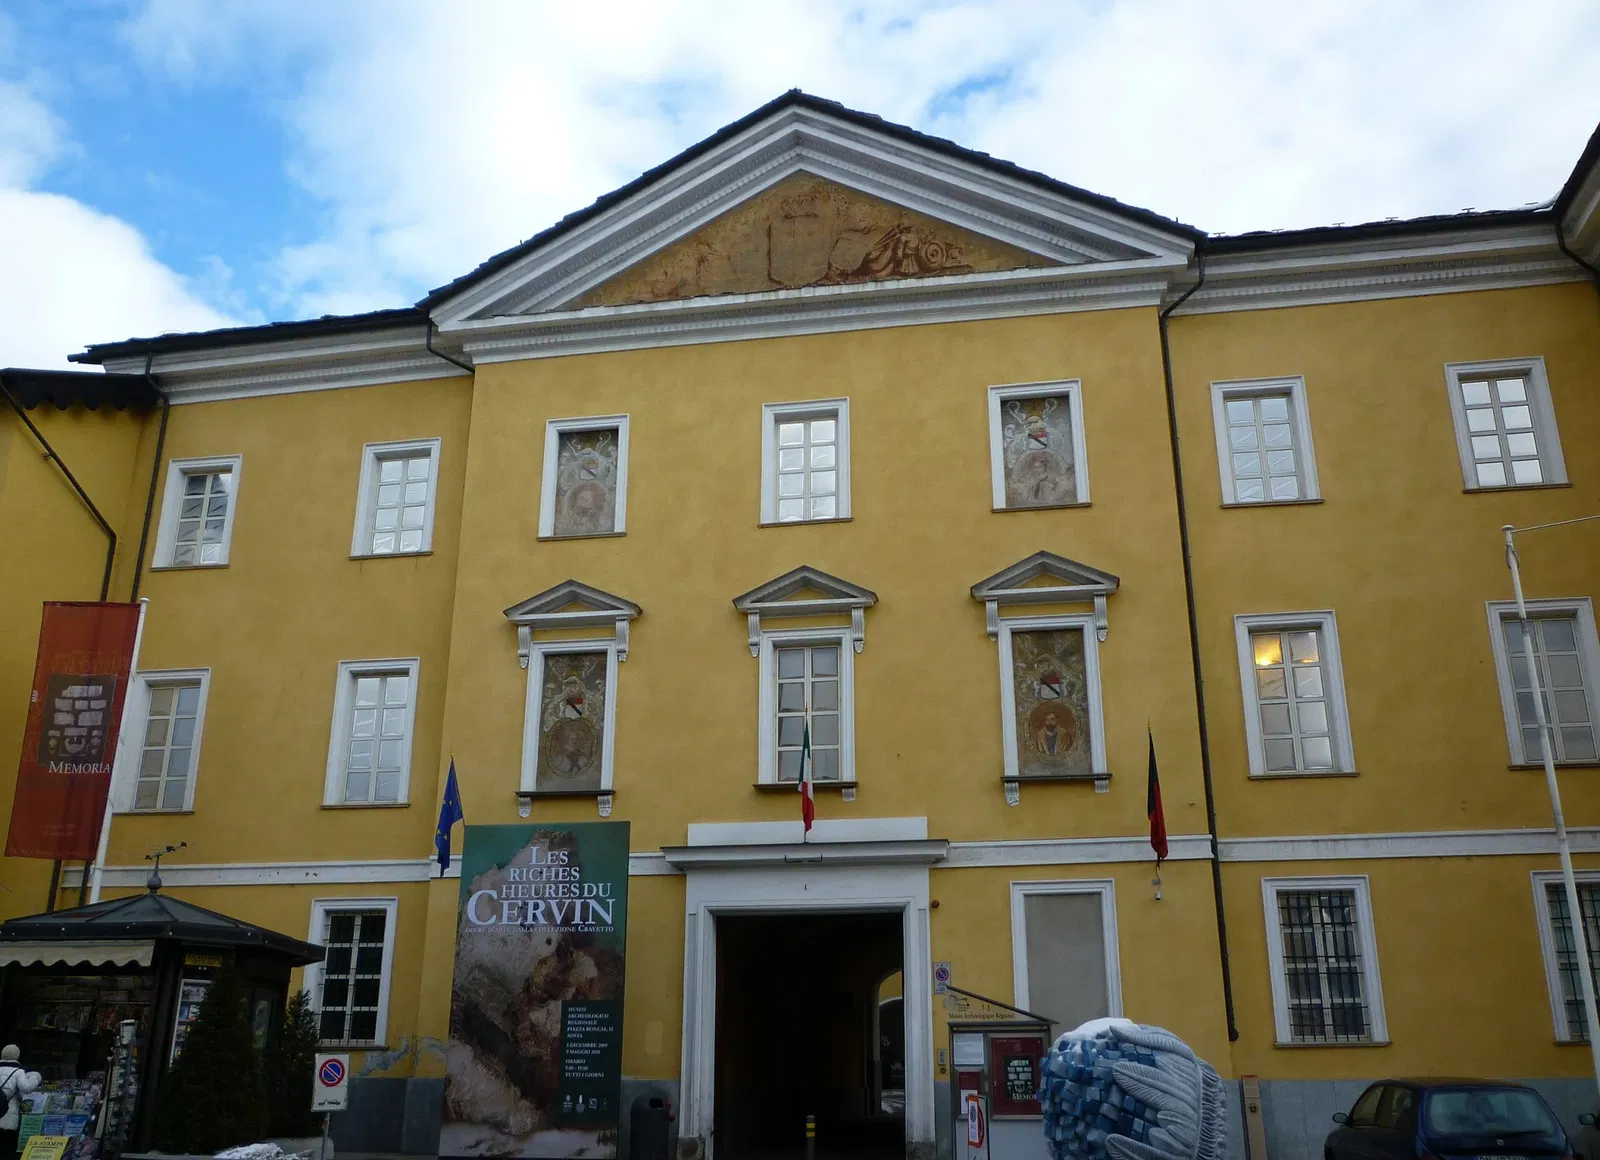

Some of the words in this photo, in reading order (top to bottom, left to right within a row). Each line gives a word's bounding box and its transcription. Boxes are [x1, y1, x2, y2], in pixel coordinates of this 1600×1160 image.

[48, 761, 110, 774] MEMORIA
[529, 846, 569, 865] LES
[508, 867, 580, 882] RICHES
[501, 883, 580, 898] HEURES
[582, 882, 611, 898] DU
[467, 889, 616, 926] CERVIN
[578, 924, 614, 933] CRAVETTO
